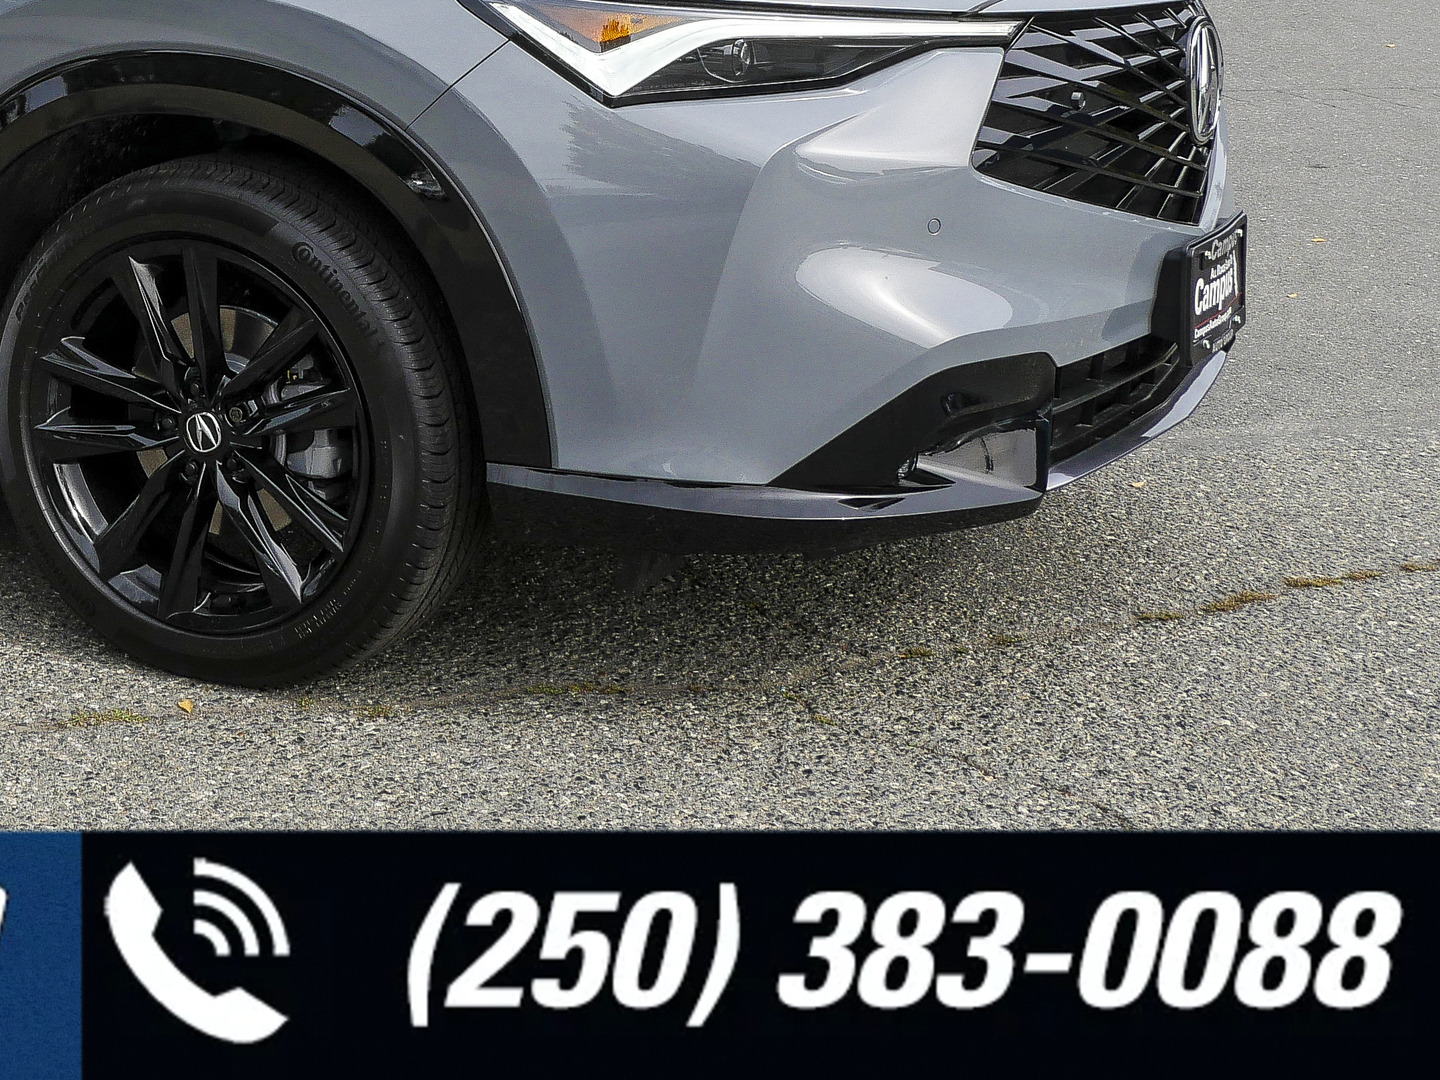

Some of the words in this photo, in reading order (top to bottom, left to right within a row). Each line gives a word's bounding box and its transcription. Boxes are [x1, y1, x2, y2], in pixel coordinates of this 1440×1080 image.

[1211, 232, 1238, 261] Campus
[290, 240, 378, 340] Continental
[1194, 268, 1234, 316] Campus
